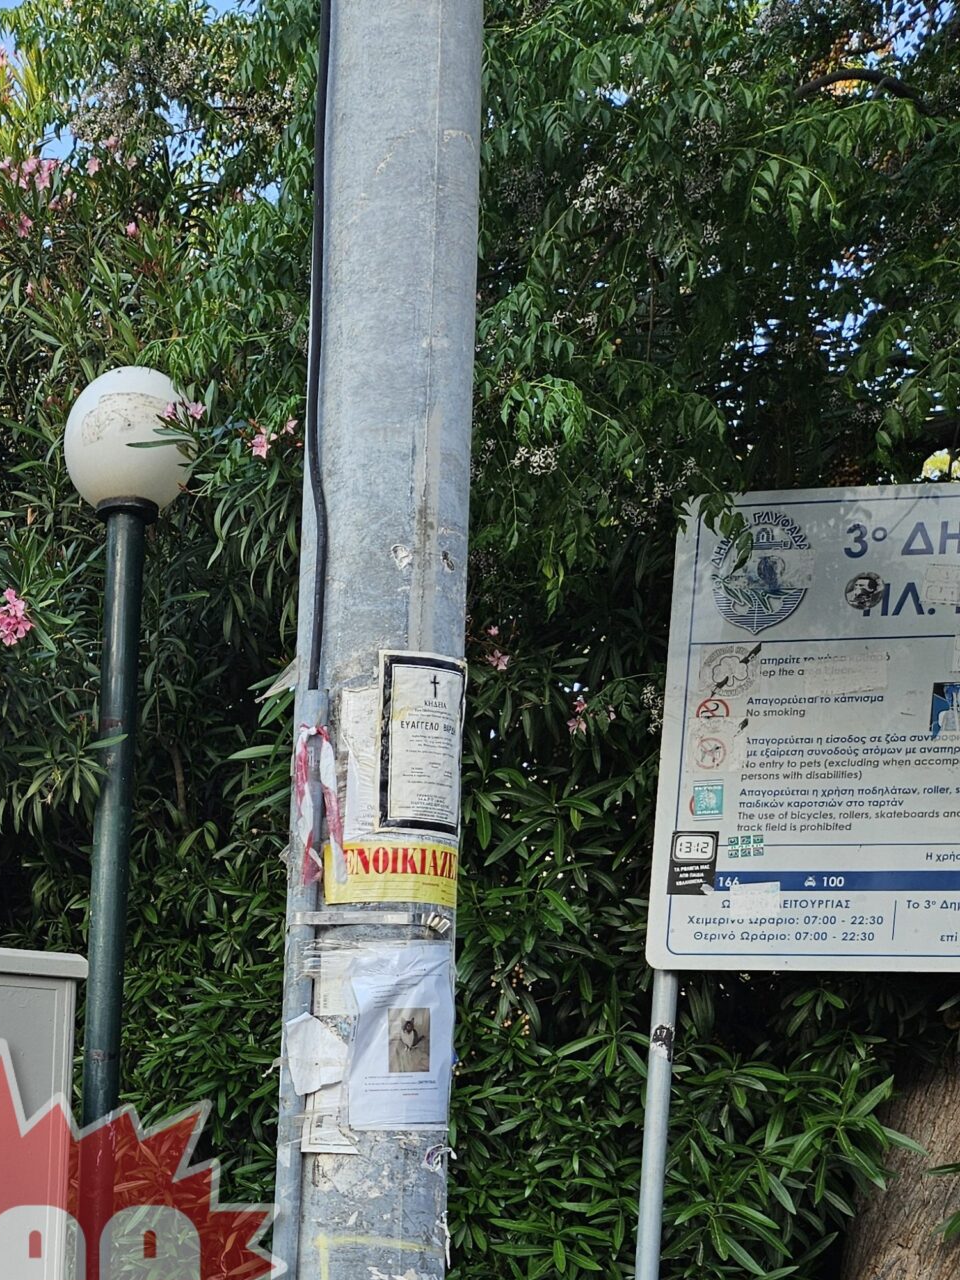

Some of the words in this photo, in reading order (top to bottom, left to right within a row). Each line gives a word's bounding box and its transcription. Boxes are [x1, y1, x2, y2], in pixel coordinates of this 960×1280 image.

[753, 511, 811, 550] ΓΛΥΦΑΔΑ
[760, 652, 800, 667] ατηρείτε
[760, 669, 776, 678] ep
[778, 667, 794, 676] the
[746, 695, 816, 707] Απαγορεύεται
[833, 694, 884, 704] κάπνισμα
[746, 709, 760, 717] No
[763, 708, 806, 718] smoking
[400, 720, 439, 731] ΕΥΑΓΓΕΛΟ
[816, 737, 823, 745] η
[825, 734, 866, 744] είσοδος
[869, 735, 882, 743] σε
[885, 733, 907, 744] ζώα
[746, 749, 758, 758] με
[760, 747, 804, 758] εξαίρεση
[807, 746, 859, 757] συνοδούς
[862, 745, 902, 756] ατόμων
[905, 747, 916, 755] με
[759, 760, 784, 770] entry
[787, 760, 797, 768] to
[800, 759, 821, 769] pets
[824, 758, 880, 769] (excluding
[883, 758, 911, 766] when
[914, 758, 959, 767] accomp
[741, 772, 780, 782] persons
[782, 771, 803, 780] with
[805, 770, 863, 780] disabilities)
[739, 787, 809, 798] Απαγορεύεται
[812, 789, 818, 797] η
[821, 786, 855, 797] χρήση
[857, 786, 920, 797] ποδηλάτων,
[923, 785, 952, 795] roller,
[739, 798, 785, 808] παιδικών
[787, 798, 844, 809] καροτσιών
[868, 797, 904, 808] ταρτάν
[738, 811, 755, 820] The
[778, 811, 788, 819] of
[790, 811, 836, 821] bicycles,
[839, 810, 872, 820] rollers,
[874, 809, 940, 819] skateboards
[737, 823, 763, 832] track
[765, 823, 787, 832] field
[789, 823, 797, 831] is
[800, 822, 852, 833] prohibited
[925, 852, 933, 860] Η
[718, 876, 740, 887] 166
[822, 876, 845, 887] 100
[779, 899, 851, 909] ΕΙΤΟΥΡΓΙΑΣ
[906, 899, 920, 909] Το
[803, 915, 837, 925] 07:00
[850, 915, 884, 925] 22:30
[693, 930, 736, 942] Θερινό
[740, 930, 790, 942] Ωράριο:
[794, 931, 828, 941] 07:00
[841, 931, 875, 941] 22:30
